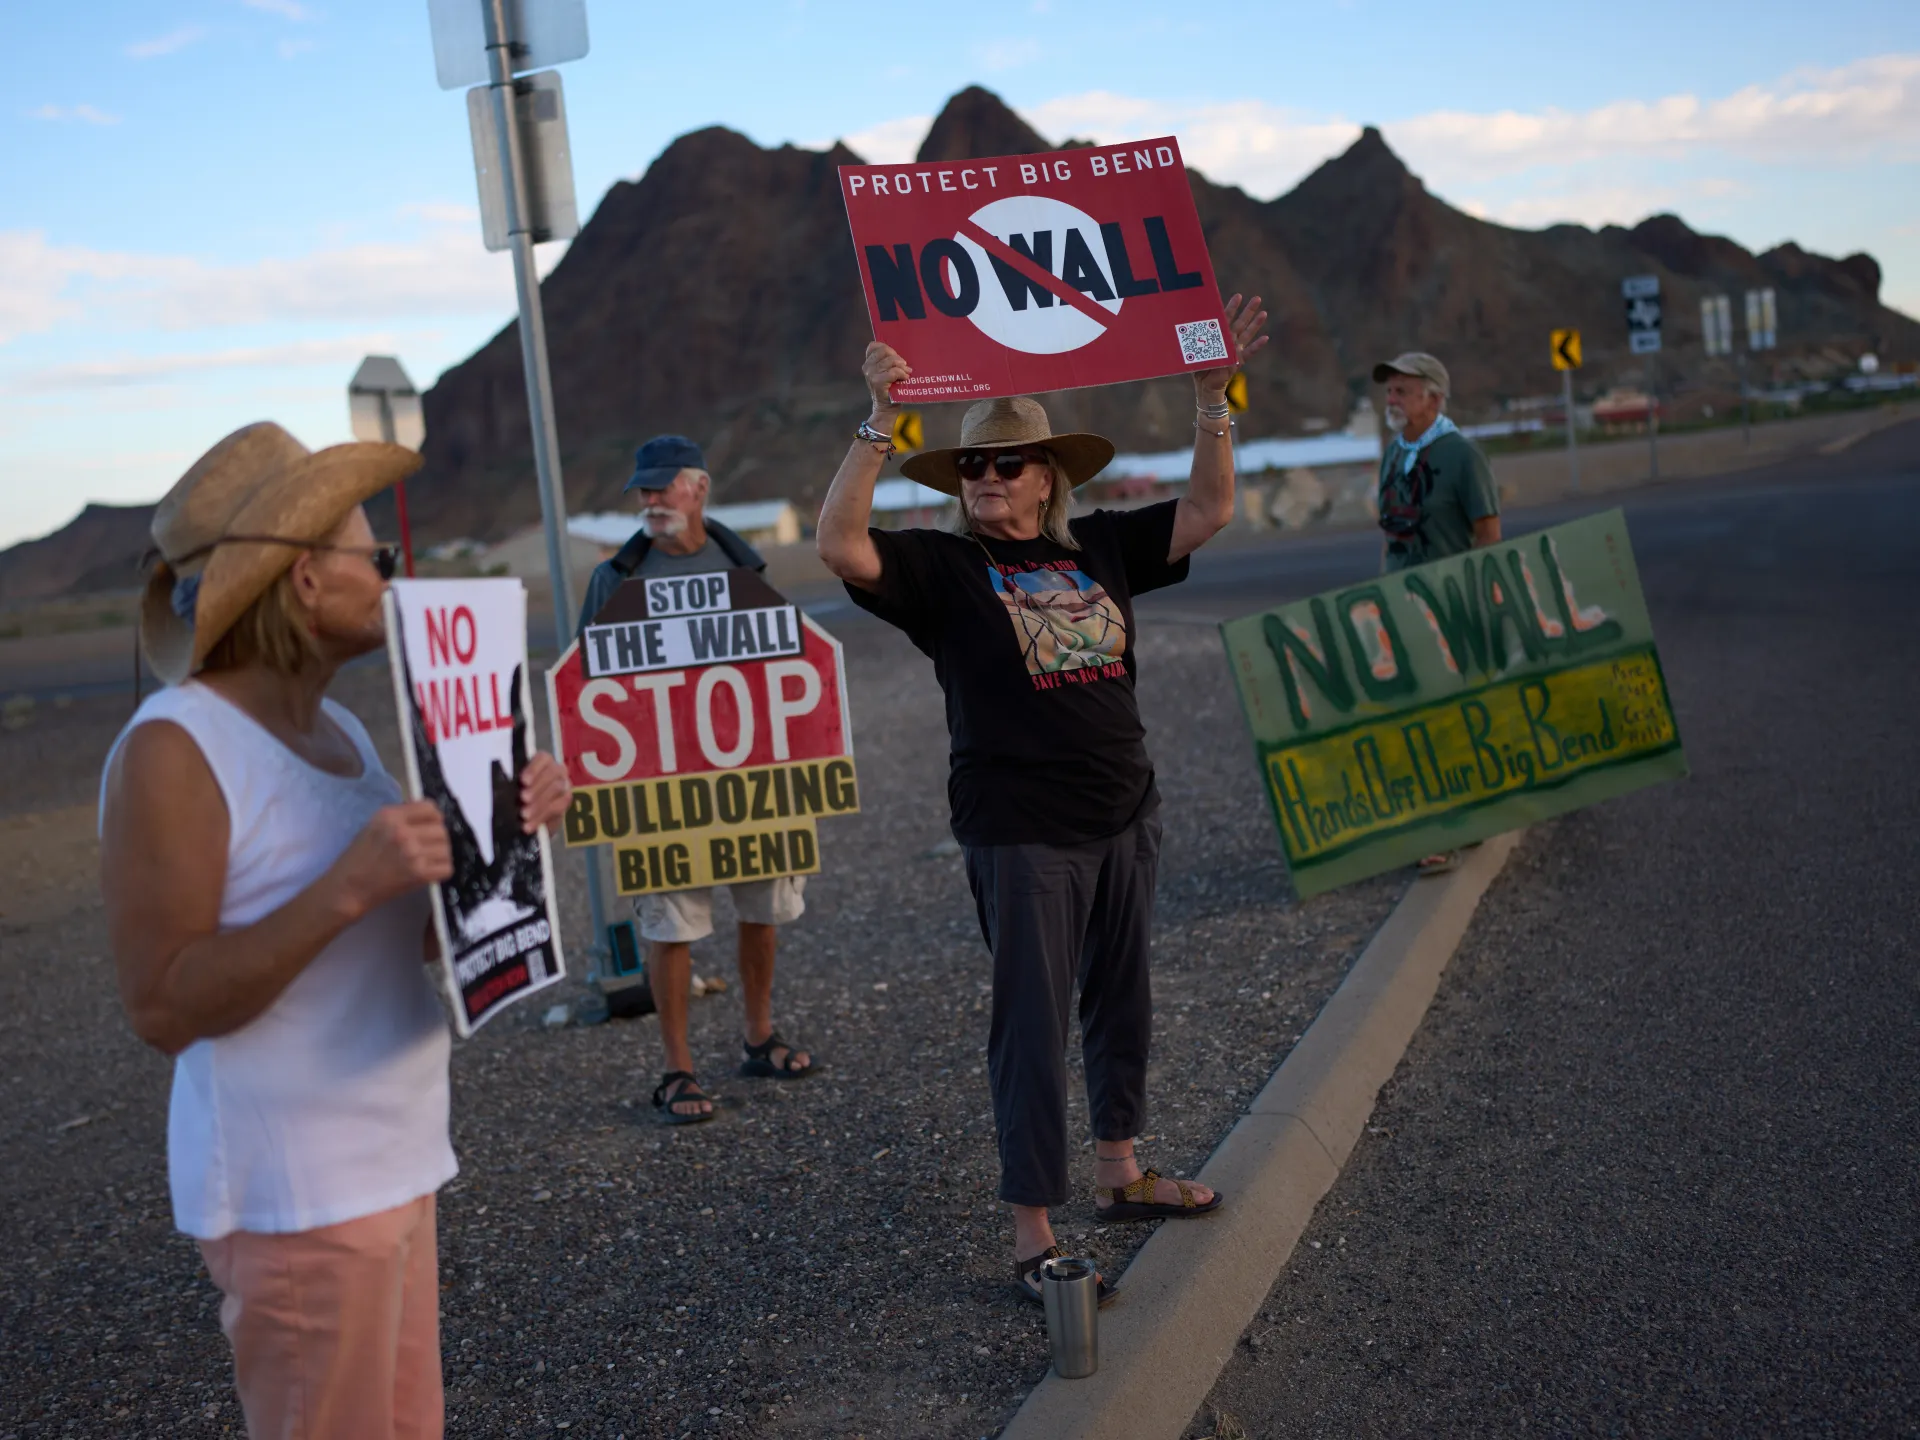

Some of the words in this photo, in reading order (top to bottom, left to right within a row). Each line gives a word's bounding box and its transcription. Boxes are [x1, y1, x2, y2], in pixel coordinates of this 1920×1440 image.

[849, 167, 998, 195] PROTECT
[1020, 160, 1072, 184] BIG
[1090, 146, 1175, 177] BEND
[864, 238, 980, 322] NO
[984, 215, 1204, 312] WALL
[896, 373, 972, 385] NOBIGBENDWALL
[897, 384, 991, 396] NOBIGBENDWALL.ORG
[649, 576, 725, 613] STOP
[425, 604, 478, 668] NO
[588, 622, 667, 671] THE
[686, 609, 797, 661] WALL
[1263, 584, 1418, 731] NO
[1404, 533, 1623, 675] WALL
[417, 672, 515, 745] WALL
[1031, 671, 1061, 691] SAVE
[1078, 665, 1099, 685] RIO
[578, 659, 822, 782] STOP
[1461, 700, 1535, 790] Big
[1519, 679, 1618, 771] Bend
[565, 760, 857, 844] BULLDOZING
[618, 842, 692, 892] BIG
[709, 828, 817, 881] BEND
[514, 918, 550, 953] BEND
